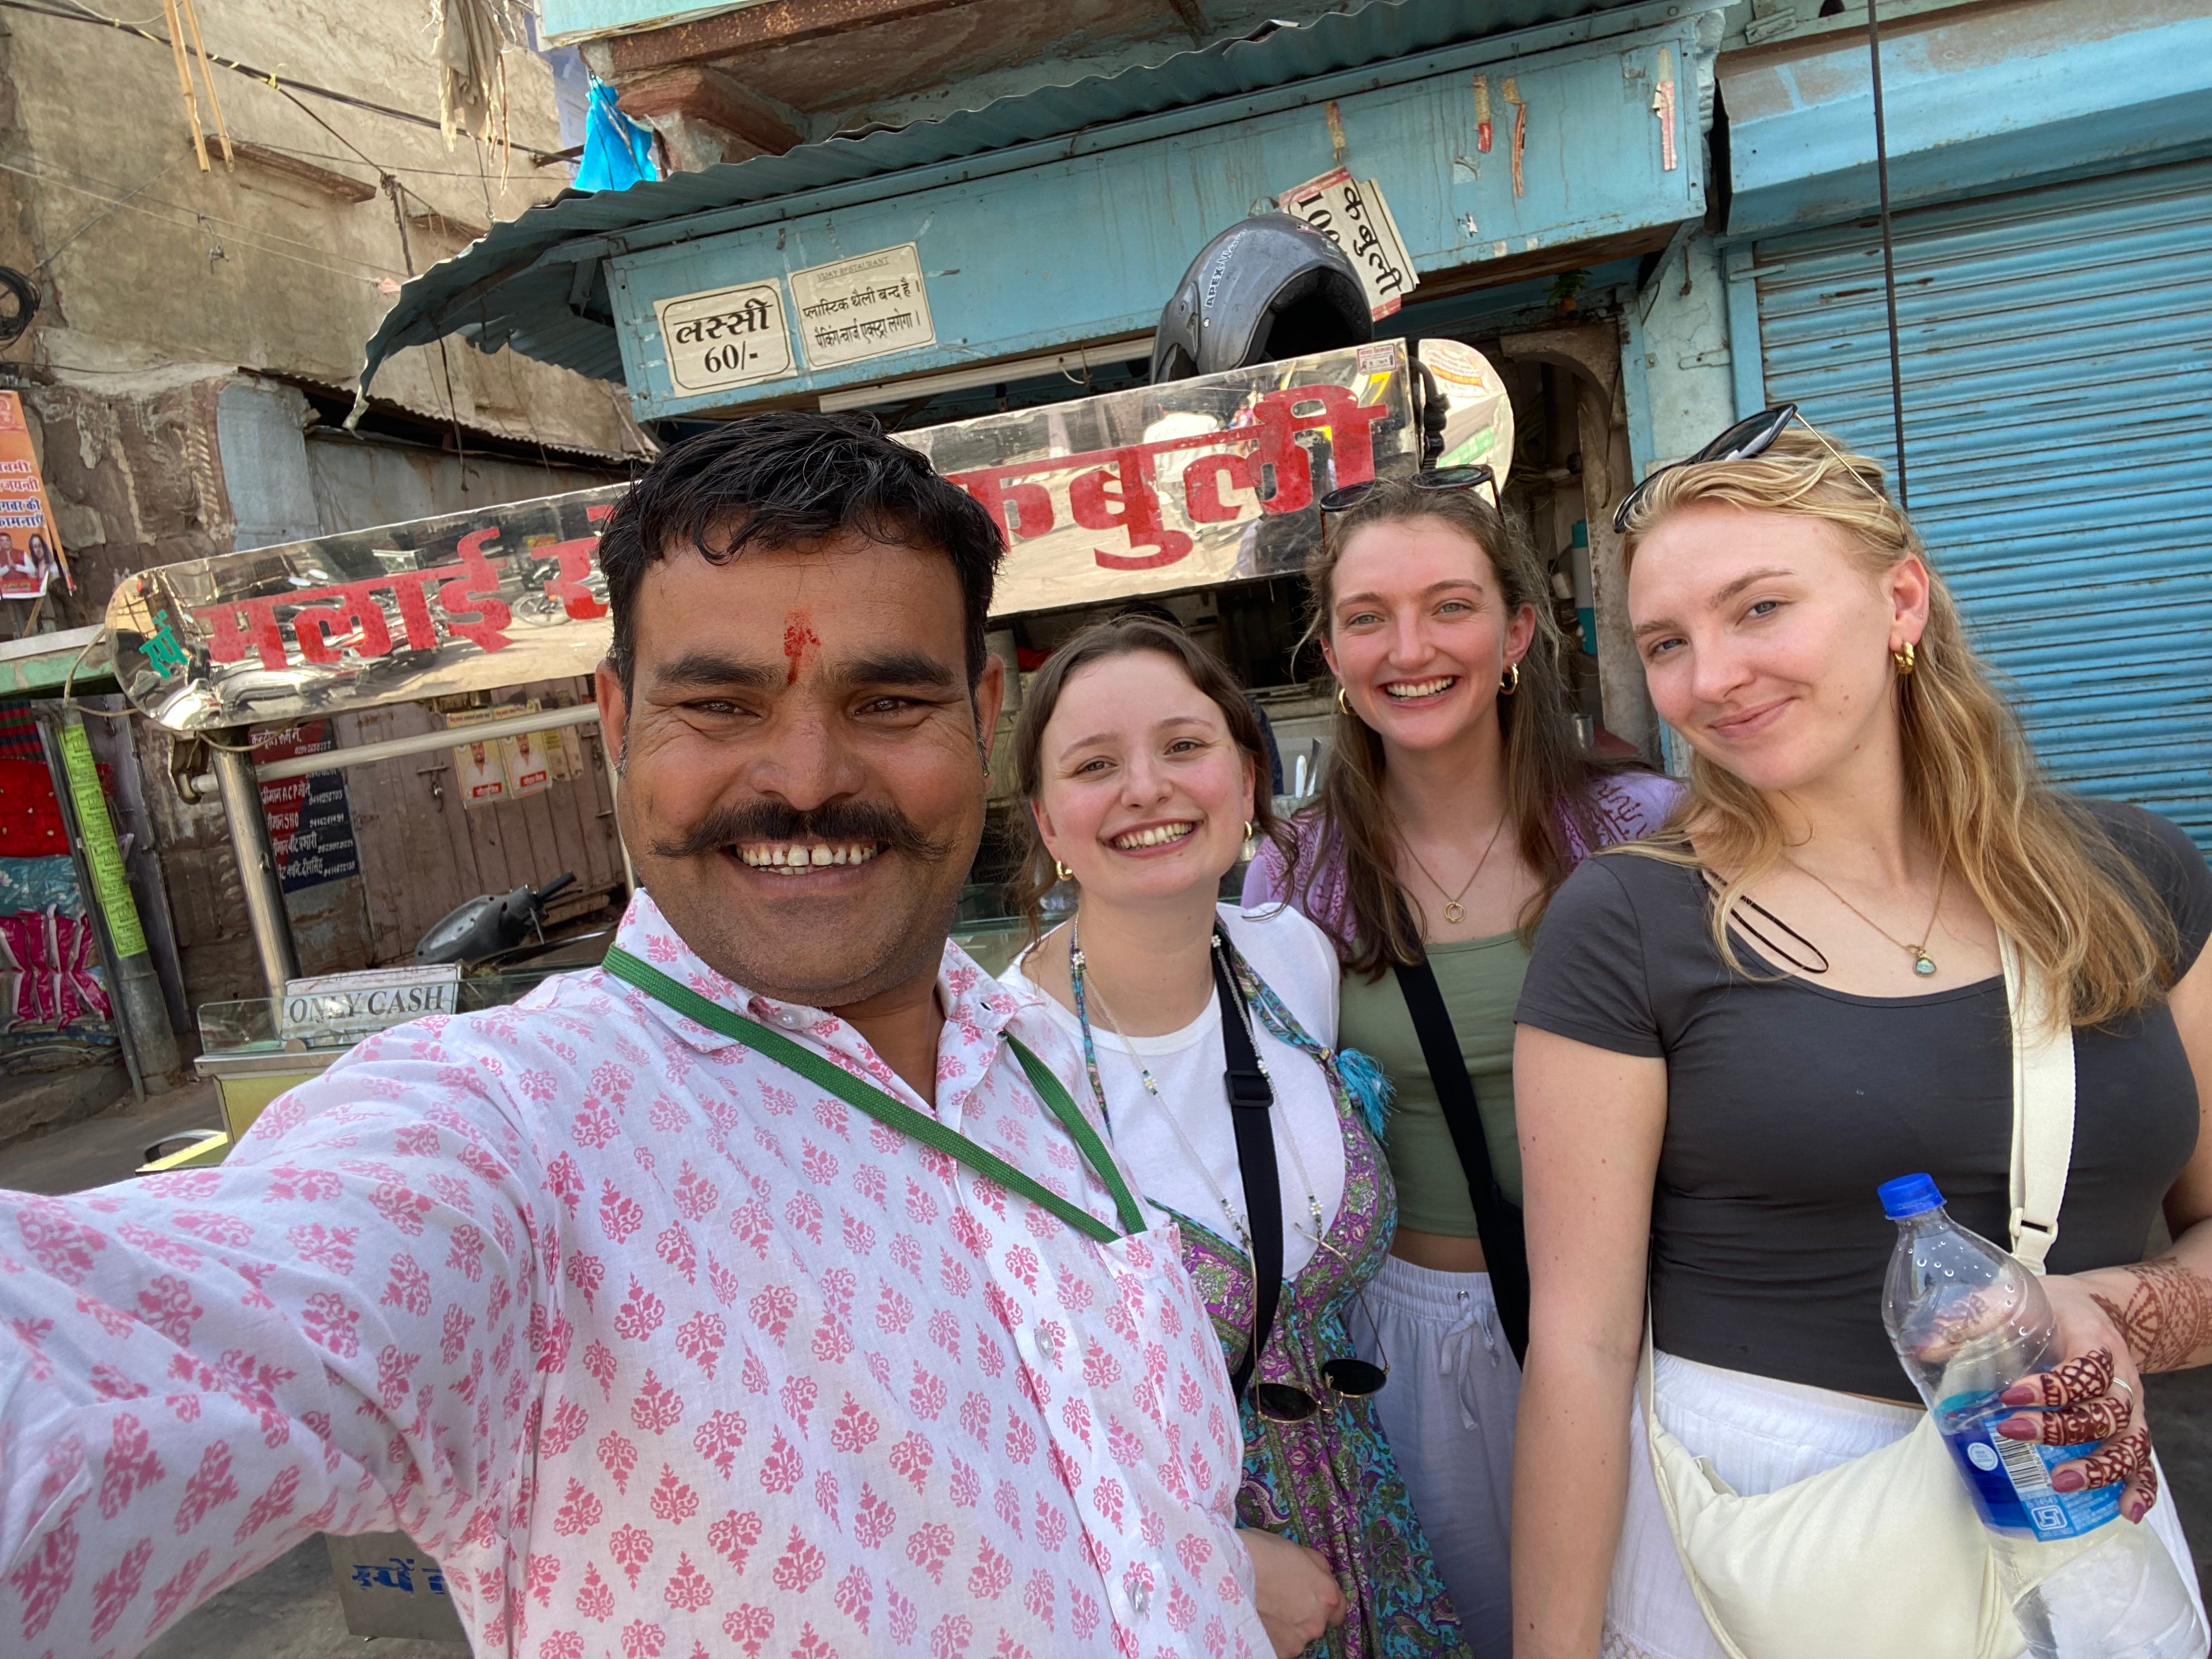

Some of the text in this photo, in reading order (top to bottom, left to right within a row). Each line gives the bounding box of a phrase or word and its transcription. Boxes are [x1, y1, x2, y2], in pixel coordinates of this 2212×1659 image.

[1344, 178, 1402, 295] कबुली
[839, 257, 890, 273] RESTAURANT
[803, 299, 849, 318] प्लास्टिक
[851, 287, 876, 306] थैली
[877, 285, 902, 300] बन्द
[902, 277, 911, 297] है
[674, 298, 774, 344] लस्सी
[887, 308, 913, 332] लगेगा
[704, 341, 758, 373] 60/-
[0, 461, 29, 472] वमी
[193, 527, 513, 673] मलाई
[284, 812, 299, 830] SHO
[367, 985, 445, 1015] CASH
